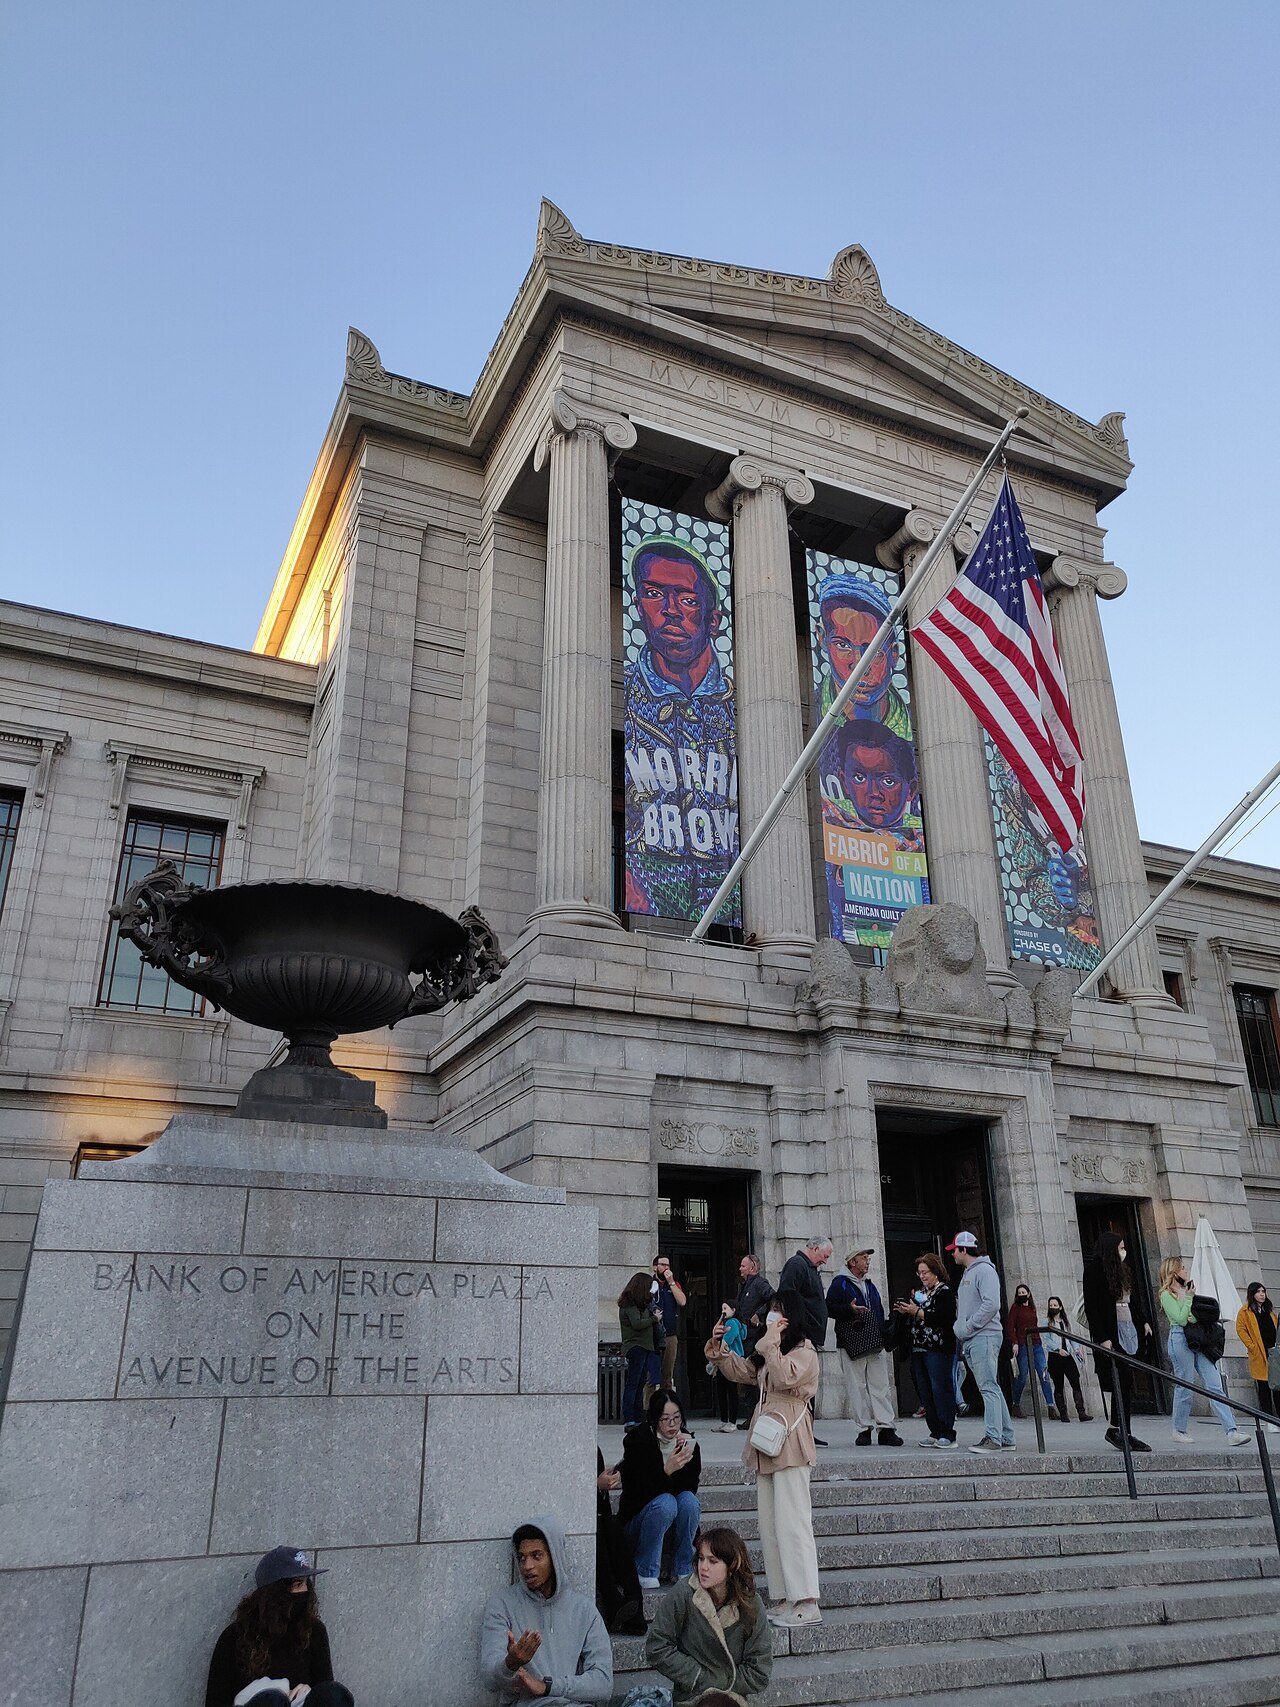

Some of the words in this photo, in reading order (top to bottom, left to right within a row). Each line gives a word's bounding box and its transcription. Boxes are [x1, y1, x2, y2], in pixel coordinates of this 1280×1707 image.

[815, 417, 850, 442] OF
[874, 435, 946, 476] FINE
[828, 831, 889, 866] FABRIC
[896, 855, 910, 872] OF
[914, 857, 923, 873] A
[849, 872, 916, 904] NATION
[844, 903, 880, 918] AMERICAN
[880, 908, 900, 921] QUILT
[1014, 938, 1051, 952] CHASE
[93, 1264, 201, 1293] BANK
[219, 1266, 269, 1294] OF
[283, 1268, 437, 1298] AMERICA
[453, 1274, 554, 1301] PLAZA
[265, 1311, 323, 1339] ON
[339, 1312, 404, 1340] THE
[122, 1357, 277, 1386] AVENUE
[292, 1356, 340, 1385] OF
[354, 1357, 419, 1384] THE
[432, 1357, 514, 1384] ARTS
